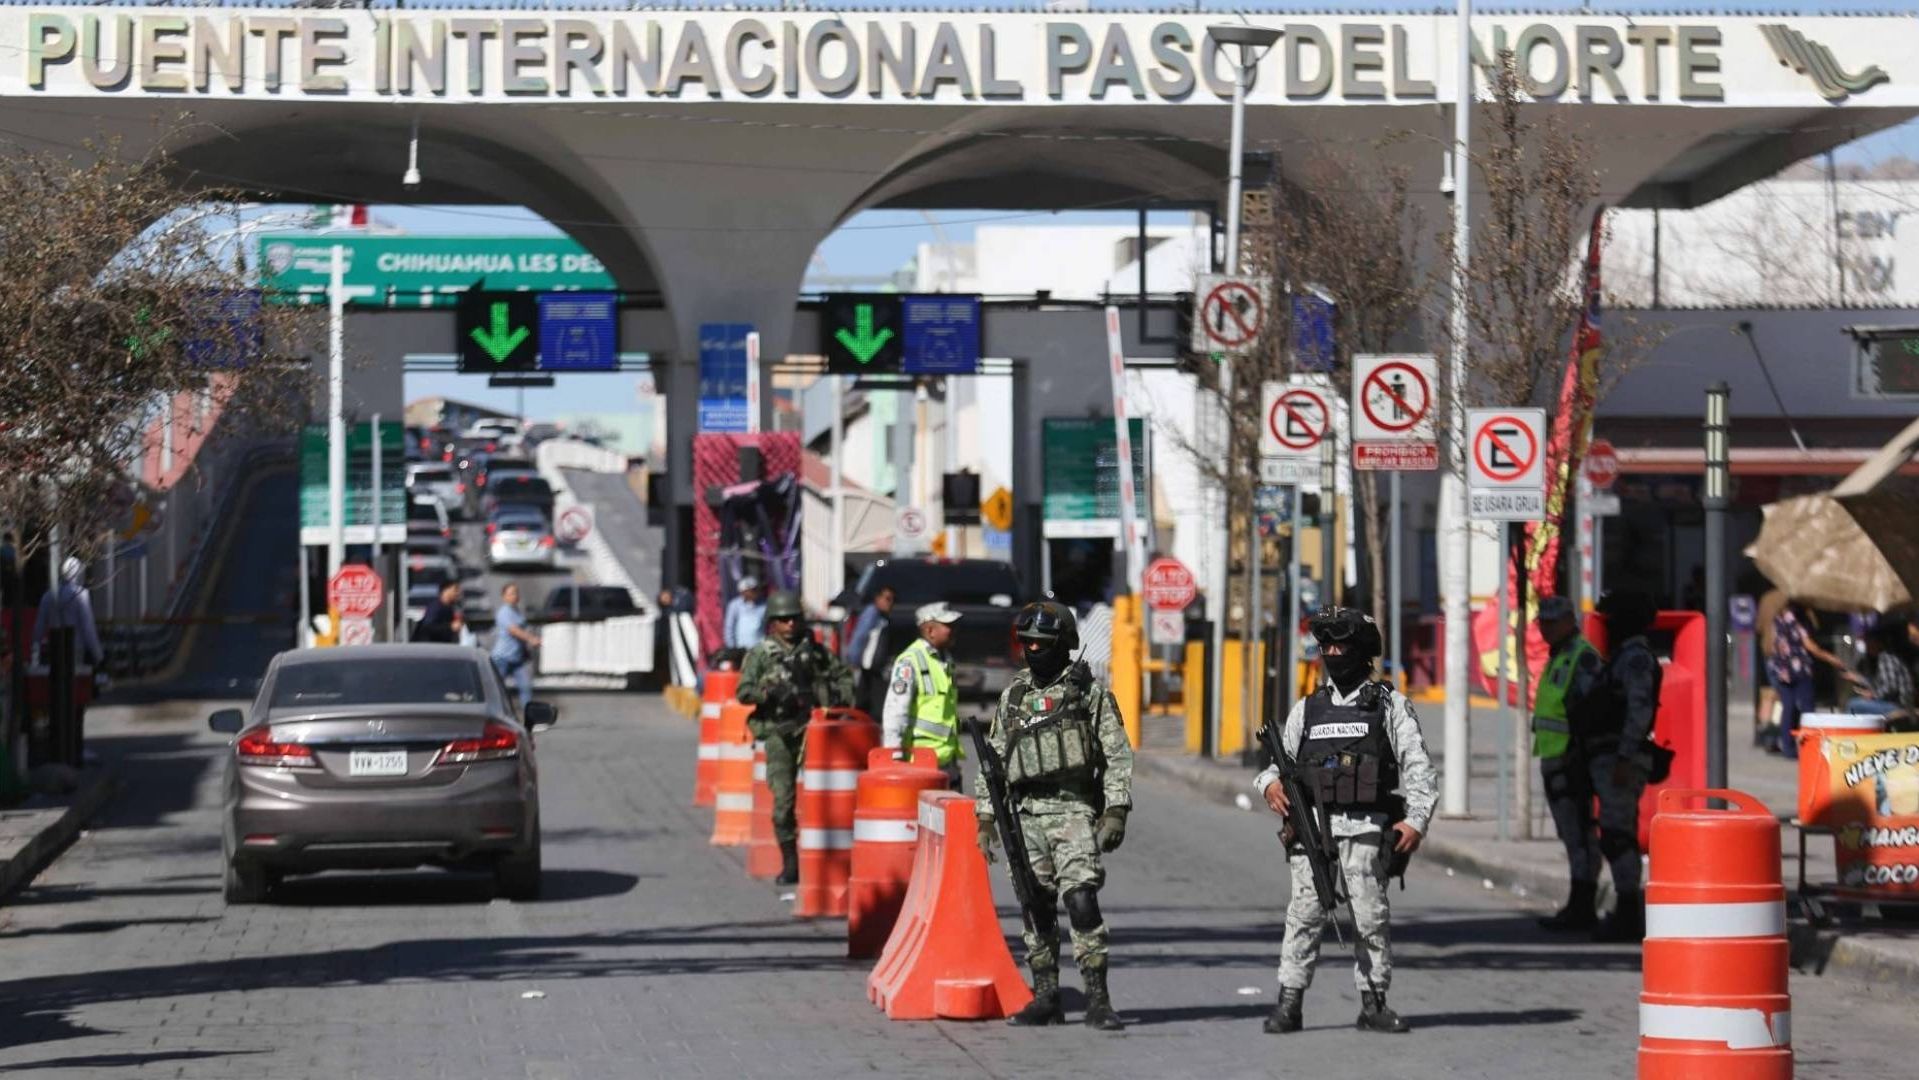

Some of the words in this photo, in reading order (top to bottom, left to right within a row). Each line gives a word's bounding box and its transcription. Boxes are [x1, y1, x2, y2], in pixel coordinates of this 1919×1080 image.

[27, 13, 347, 93] PUENTE
[375, 17, 1023, 101] INTERNACIONAL
[1045, 22, 1258, 101] PASO
[1284, 23, 1437, 101] DEL
[1466, 23, 1725, 102] NORTE
[377, 253, 515, 273] CHIHUAHUA
[518, 253, 558, 273] LES
[1364, 446, 1428, 457] PROHIBIDO
[1473, 495, 1482, 512] SE
[1485, 495, 1513, 512] USARA
[1515, 495, 1540, 512] GRUA
[334, 574, 375, 591] ALTO
[1149, 569, 1189, 585] ALTO
[335, 594, 377, 611] STOP
[1149, 590, 1190, 603] STOP
[1311, 725, 1336, 738] GUARDIA
[1336, 723, 1367, 736] NACIONAL
[1844, 750, 1899, 788] NIEVE
[1861, 827, 1919, 847] MANG
[1865, 863, 1919, 884] COCO
